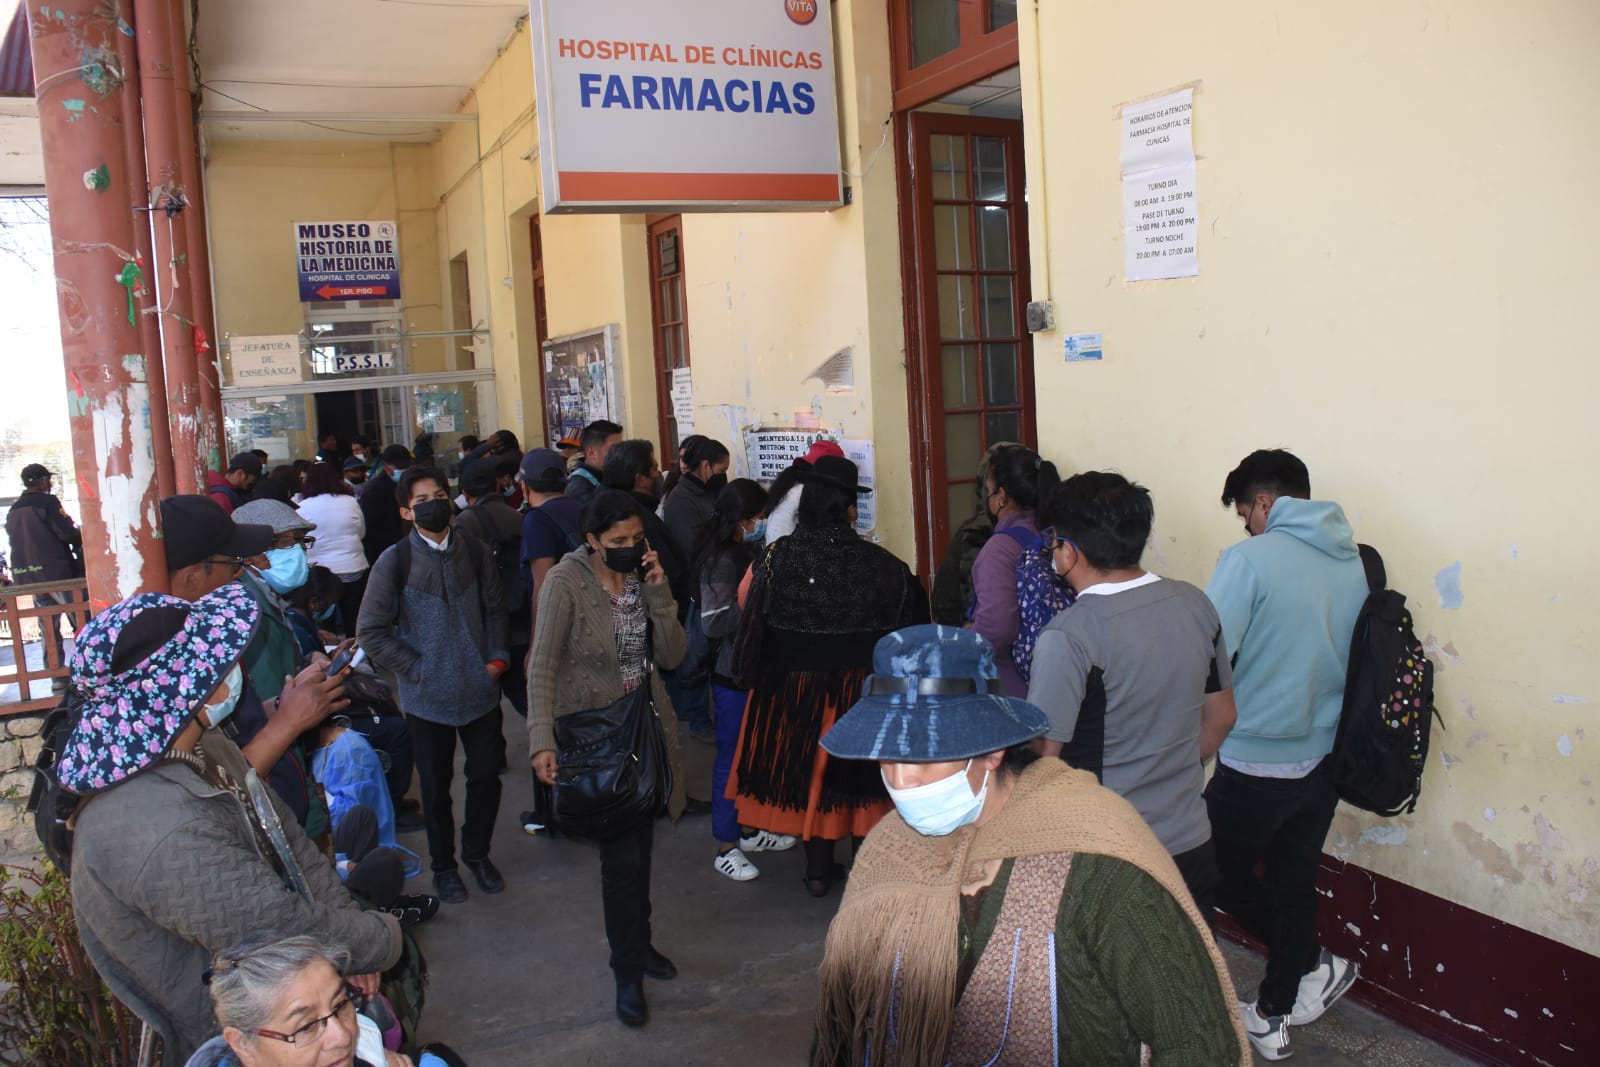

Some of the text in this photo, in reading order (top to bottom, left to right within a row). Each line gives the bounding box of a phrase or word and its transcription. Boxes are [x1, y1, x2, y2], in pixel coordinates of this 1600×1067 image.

[790, 1, 814, 12] VITA
[559, 38, 822, 70] HOSPITAL DE CLÍNICAS
[579, 73, 815, 115] FARMACIAS
[1130, 113, 1156, 125] HORARIOS
[1165, 103, 1192, 116] ATENCION
[1130, 126, 1156, 138] FARMACIA
[1157, 120, 1182, 131] HOSPITAL
[1146, 136, 1169, 146] CLINICAS
[1148, 182, 1166, 191] TURNO
[1168, 193, 1182, 201] 19:00
[1165, 207, 1184, 216] TURNO
[298, 224, 370, 238] MUSEO
[1165, 233, 1184, 241] NOCHE
[299, 240, 392, 255] HISTORIA DE
[301, 257, 396, 272] LA MEDICINA
[242, 342, 291, 352] JEFATURA
[336, 355, 389, 370] P.S.S.I.
[240, 366, 297, 378] ENSEÑANZA
